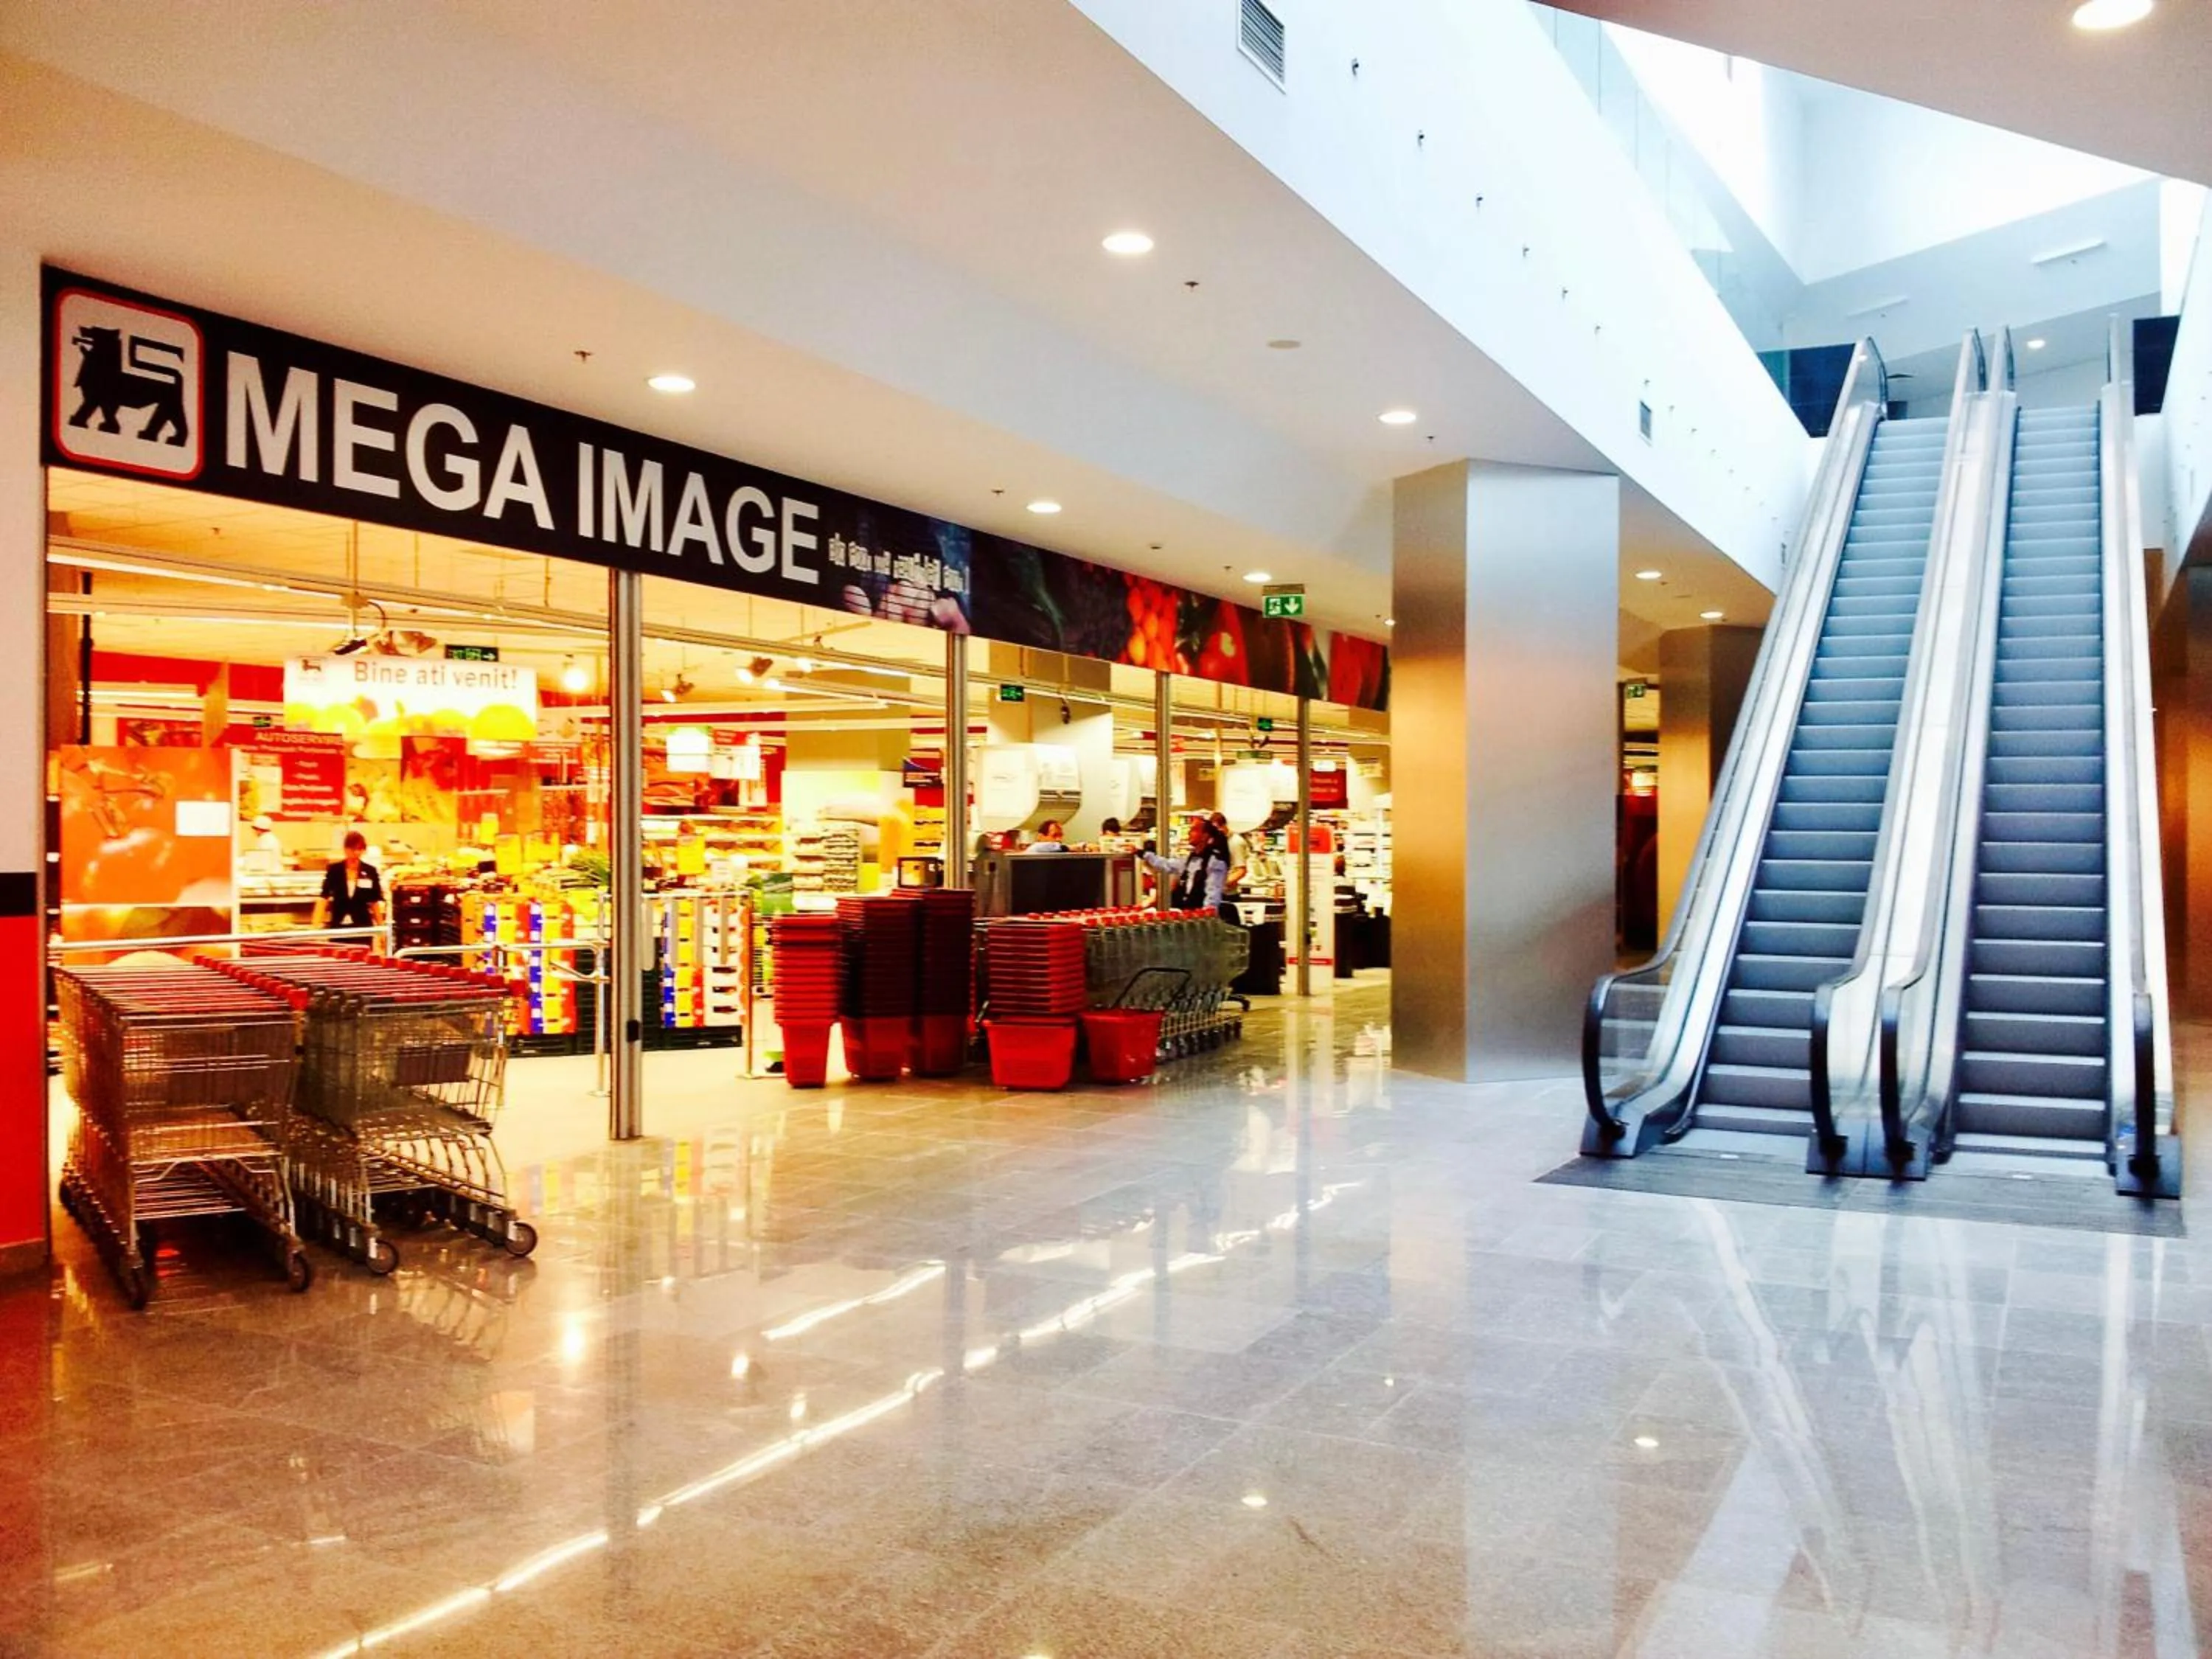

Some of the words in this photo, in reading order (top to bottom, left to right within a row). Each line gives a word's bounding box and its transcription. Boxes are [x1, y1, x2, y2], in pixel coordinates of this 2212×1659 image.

[225, 350, 554, 531] MEGA
[578, 442, 819, 585] IMAGE
[355, 661, 407, 684] Bine
[452, 669, 518, 689] venit!
